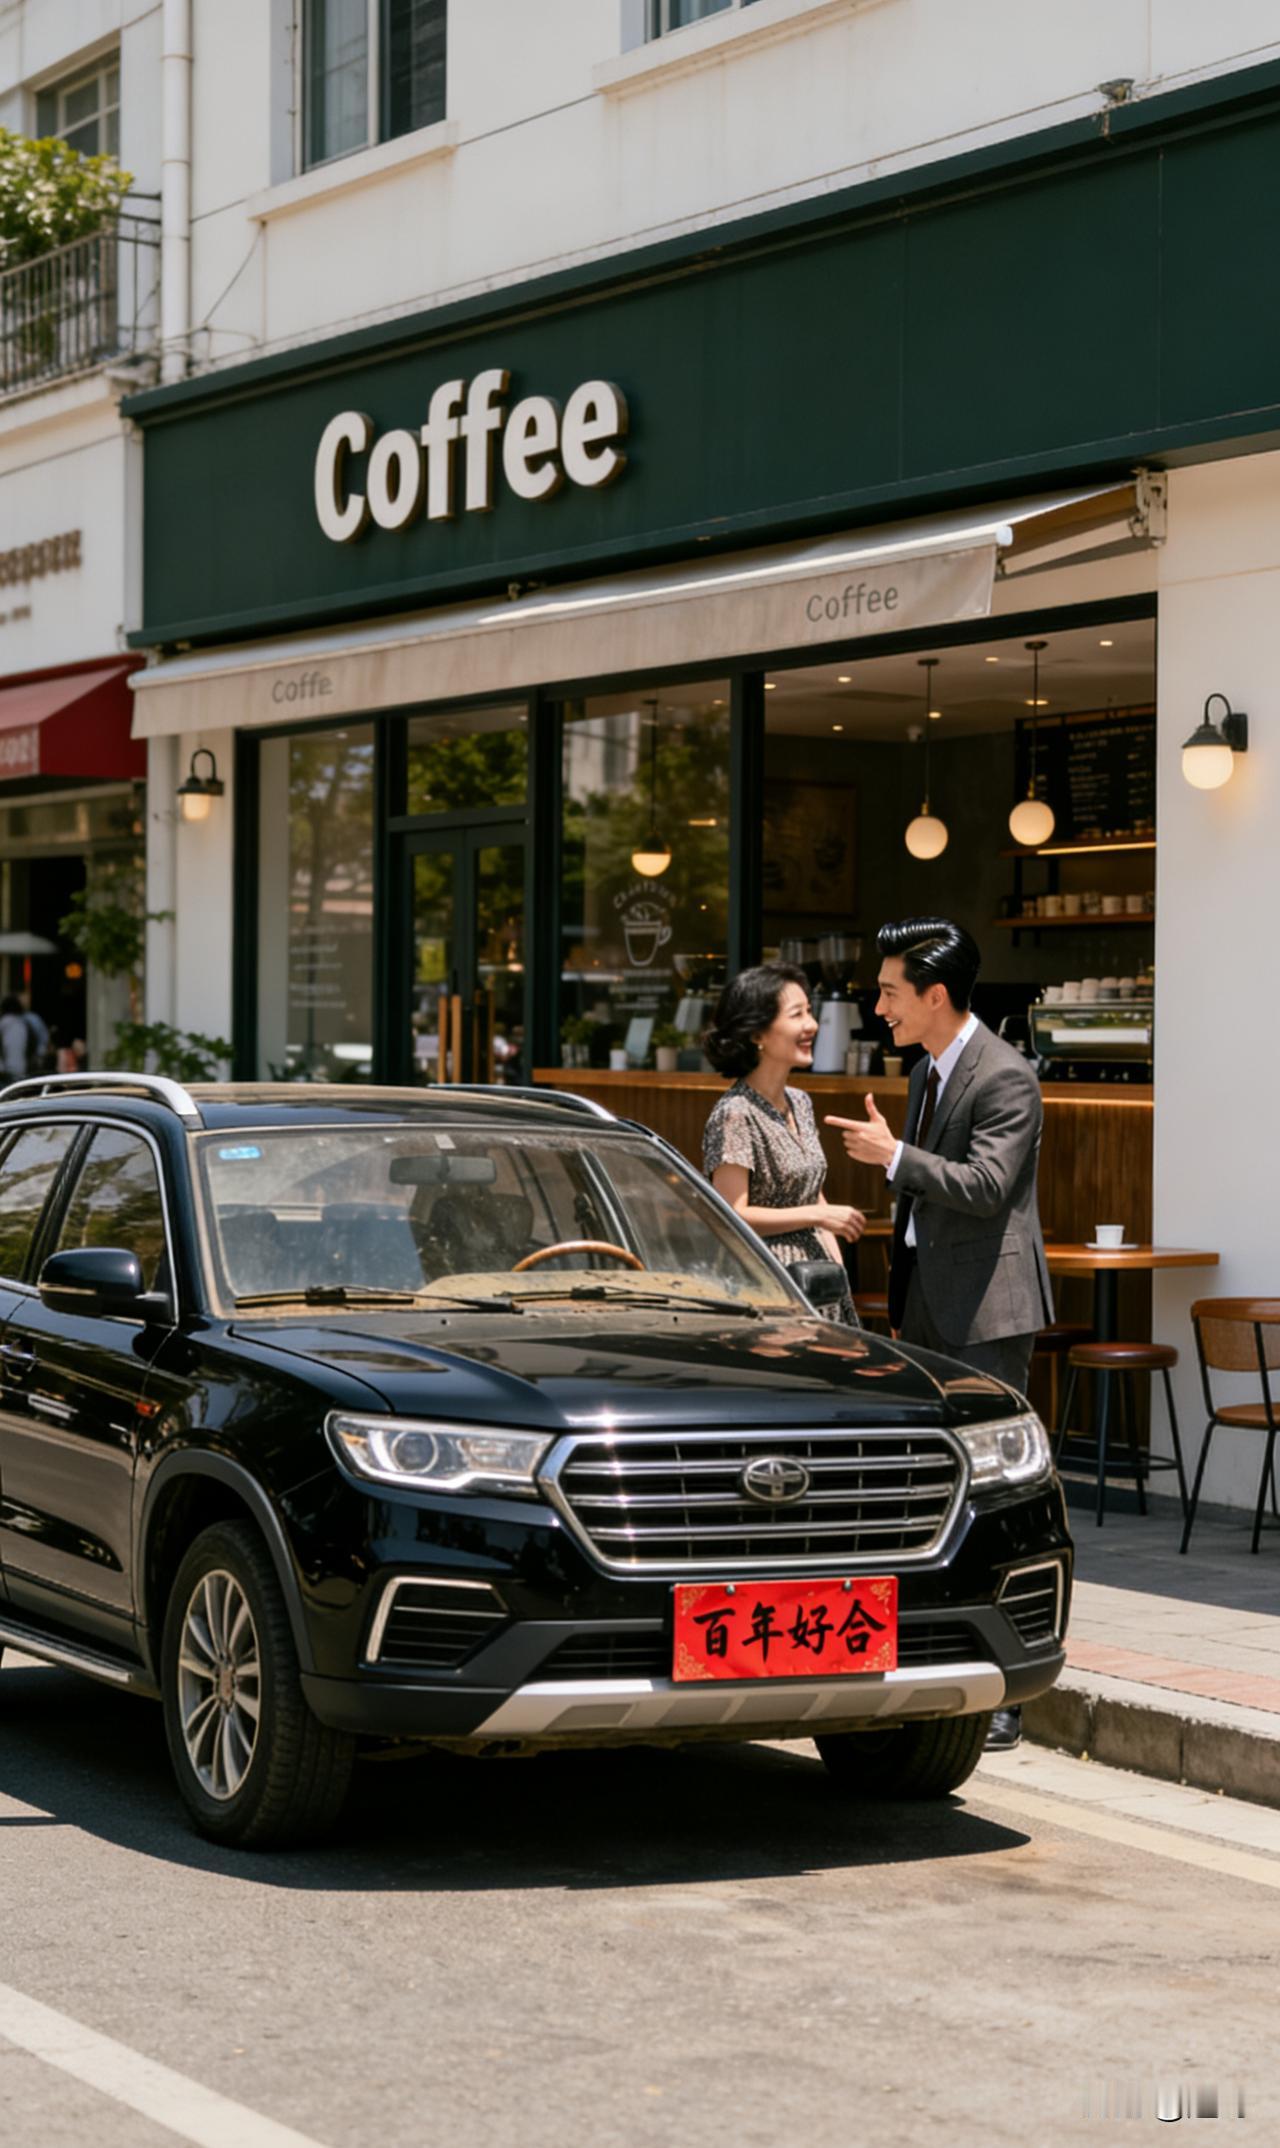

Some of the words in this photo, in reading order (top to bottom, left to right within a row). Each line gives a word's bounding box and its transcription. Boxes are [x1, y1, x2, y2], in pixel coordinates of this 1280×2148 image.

[315, 369, 627, 543] Coffee
[806, 582, 898, 622] Coffee
[272, 671, 334, 704] Coffe
[693, 1599, 886, 1663] 百年好合
